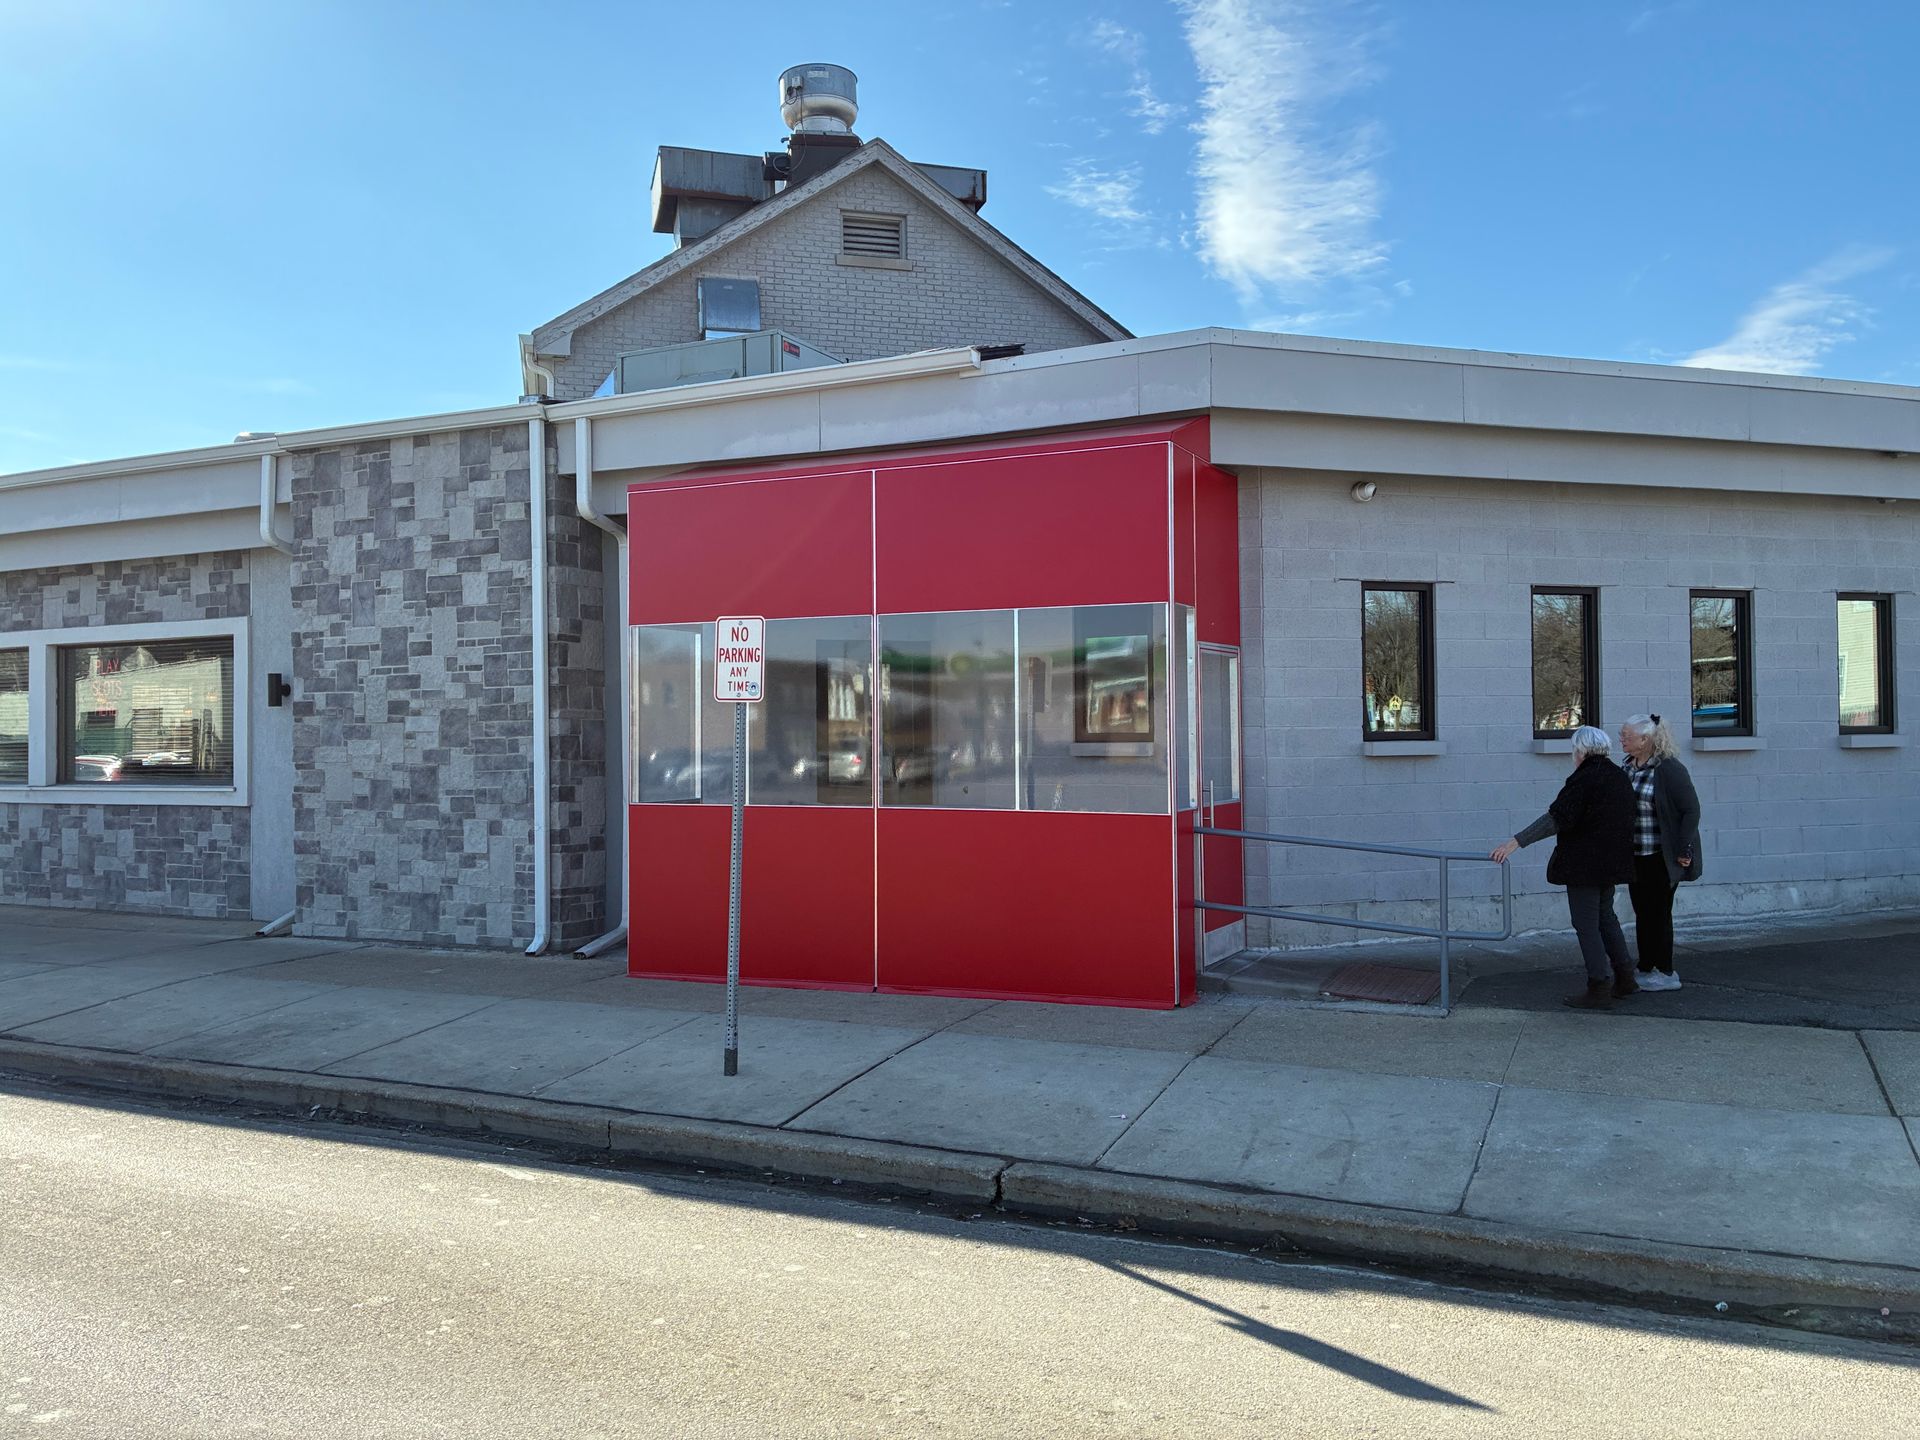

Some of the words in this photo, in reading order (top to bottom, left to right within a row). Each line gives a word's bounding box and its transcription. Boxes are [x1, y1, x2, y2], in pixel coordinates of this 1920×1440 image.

[731, 626, 749, 642] NO
[719, 647, 761, 663] PARKING
[96, 658, 120, 675] PLAY
[730, 667, 749, 677] ANY
[93, 680, 122, 697] SLOTS
[727, 681, 750, 692] TIME
